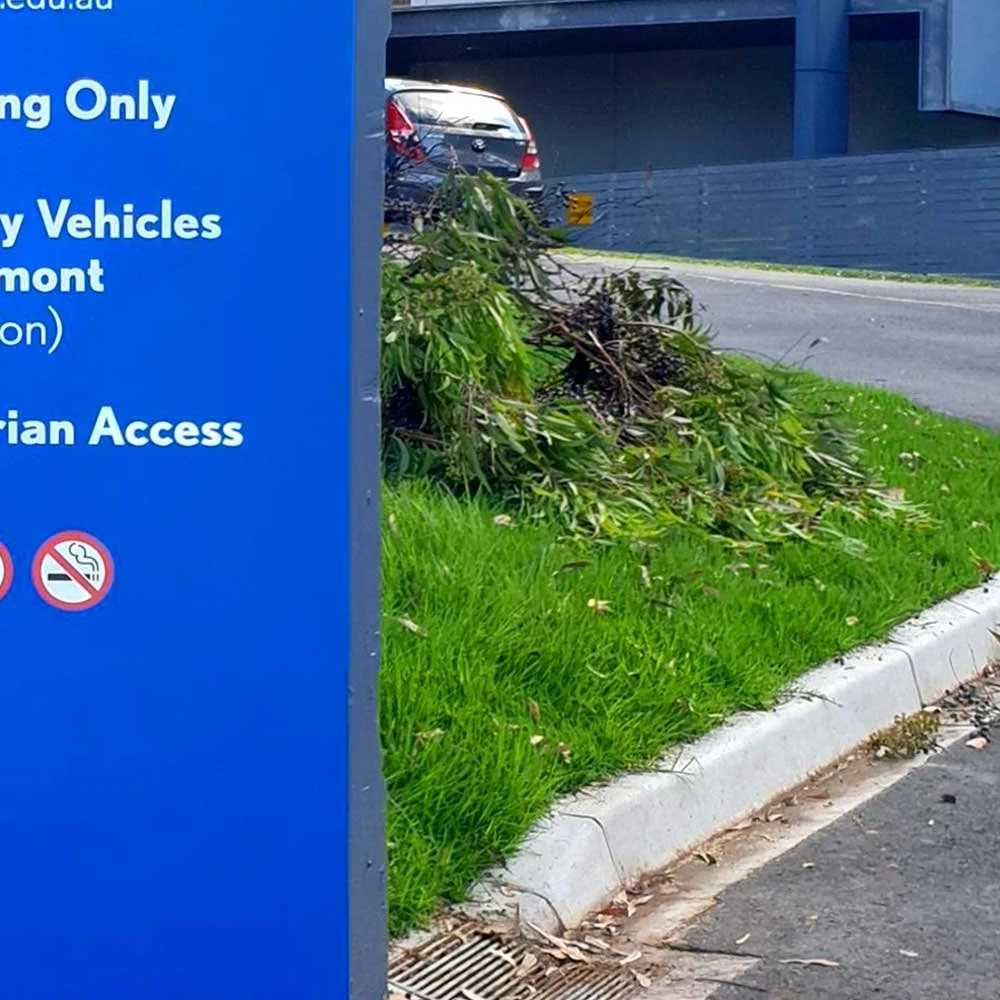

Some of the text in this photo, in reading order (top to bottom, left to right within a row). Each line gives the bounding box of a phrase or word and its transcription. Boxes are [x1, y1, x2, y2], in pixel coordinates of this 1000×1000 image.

[65, 79, 176, 129] Only
[37, 199, 222, 240] Vehicles
[88, 406, 243, 447] Access
